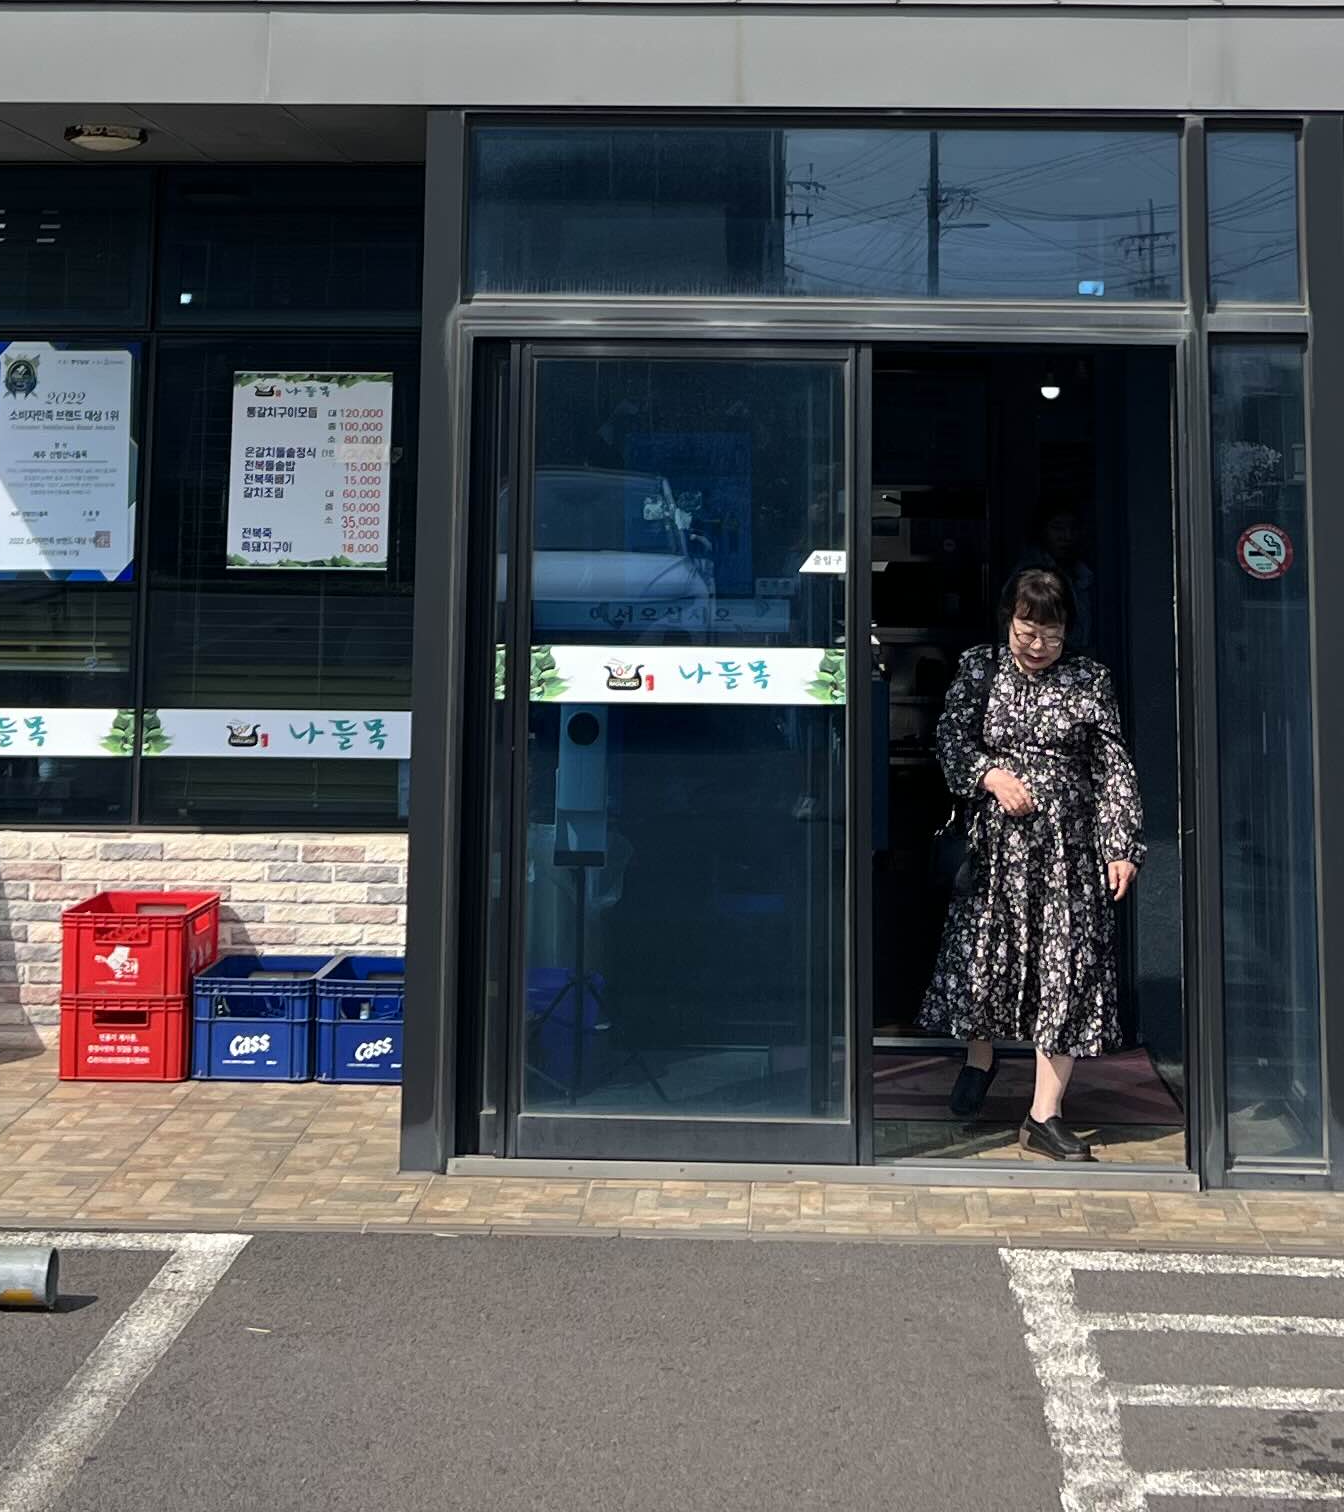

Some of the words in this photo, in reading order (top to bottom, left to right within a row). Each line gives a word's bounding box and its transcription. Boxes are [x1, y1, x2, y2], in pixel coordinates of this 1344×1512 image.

[286, 385, 331, 397] 나들목
[45, 391, 87, 405] 2022
[9, 409, 53, 422] 소비자만족
[56, 409, 82, 422] 브랜드
[84, 409, 103, 422] 대상
[105, 410, 120, 422] 1위
[328, 409, 337, 418] 대
[243, 487, 284, 499] 갈치조림
[325, 489, 334, 498] 대
[241, 527, 272, 539] 전복죽
[678, 660, 772, 689] 나들목
[288, 717, 389, 751] 나들목
[229, 1033, 271, 1057] Cass
[354, 1036, 394, 1062] Cass
